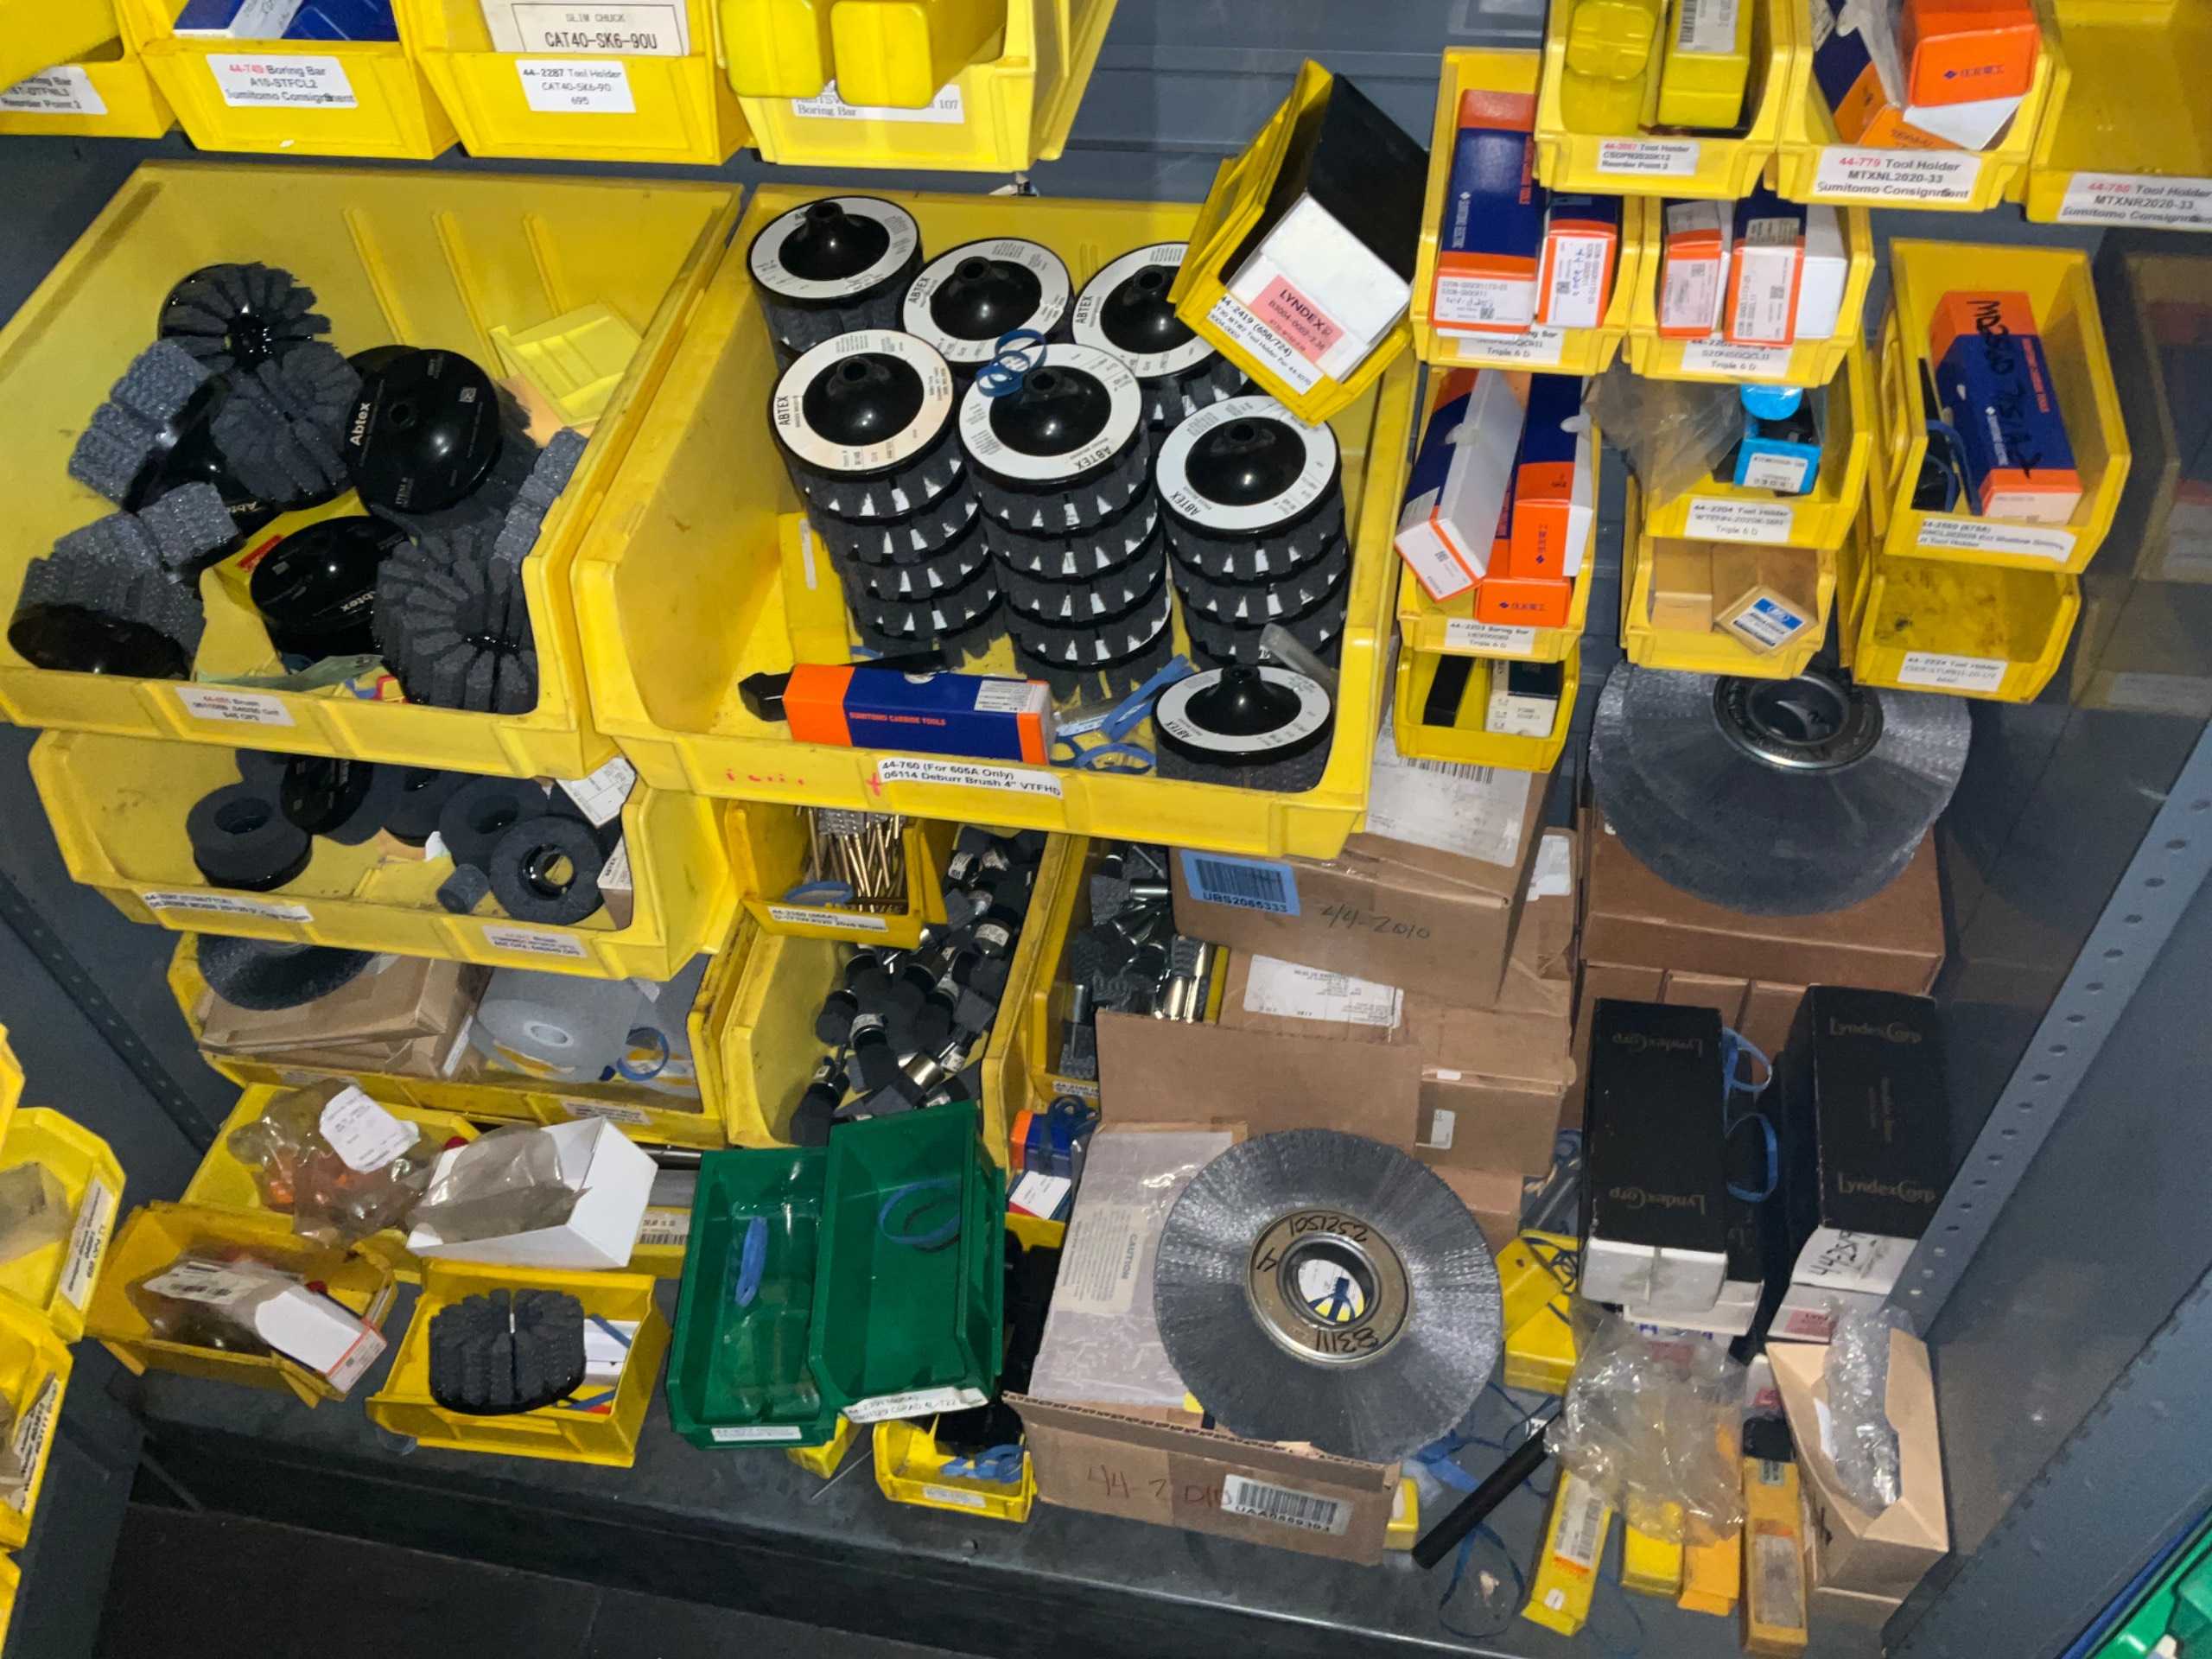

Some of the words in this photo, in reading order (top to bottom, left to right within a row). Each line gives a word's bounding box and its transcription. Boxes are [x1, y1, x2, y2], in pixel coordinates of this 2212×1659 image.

[544, 32, 658, 49] CAT40-SK6-90U
[798, 105, 834, 117] Boring
[837, 106, 856, 117] Bar
[1847, 169, 1944, 184] MTXNL2020-33
[1885, 158, 1913, 169] Tool
[1916, 160, 1961, 172] Holder
[1818, 181, 1879, 194] Sumitomo
[2136, 184, 2164, 194] Tool
[2094, 195, 2194, 210] MTXNR2020-33
[907, 276, 931, 304] ABTEX
[1076, 295, 1093, 325] ABTEX
[1279, 289, 1324, 332] LYNDEX
[779, 396, 791, 426] ABTEX
[349, 402, 372, 447] Abtex
[1075, 446, 1112, 470] ABTEX
[1170, 490, 1201, 517] ABTEX
[921, 772, 961, 784] Deburr
[965, 776, 1001, 787] Brush
[982, 768, 1014, 780] Only)
[1829, 1016, 1923, 1044] LyndexCorp
[1611, 1032, 1704, 1058] LyndexCorp
[1838, 1172, 1937, 1205] LyndexCorp
[1610, 1186, 1707, 1217] LyndexCorp
